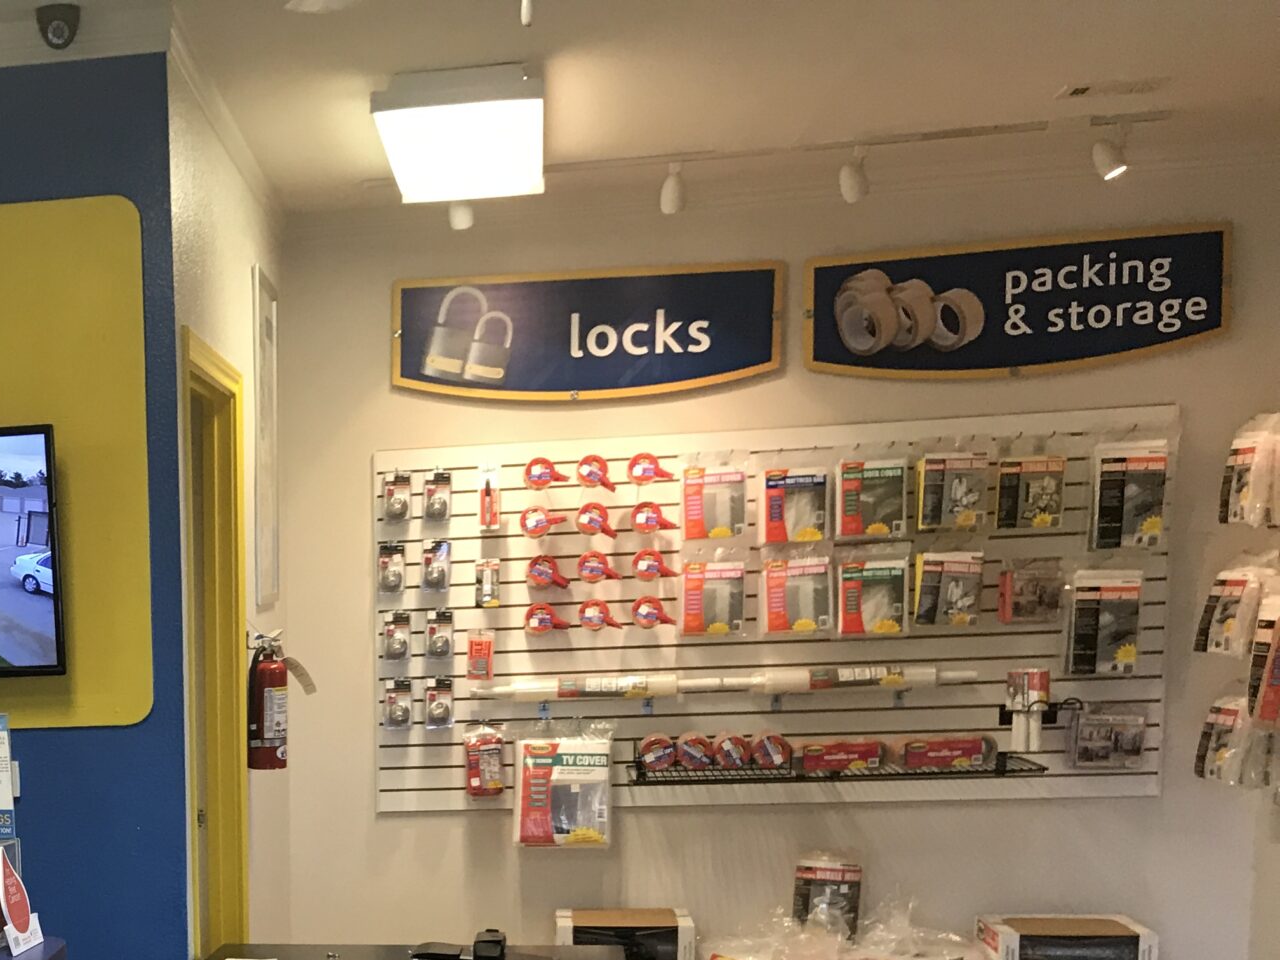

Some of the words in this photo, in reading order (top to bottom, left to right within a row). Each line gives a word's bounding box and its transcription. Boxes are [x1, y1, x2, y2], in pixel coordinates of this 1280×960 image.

[1004, 252, 1172, 304] packing
[569, 308, 711, 359] locks
[1003, 303, 1033, 336] &
[1046, 296, 1208, 334] storage
[561, 755, 576, 766] TV
[576, 755, 607, 766] COVER
